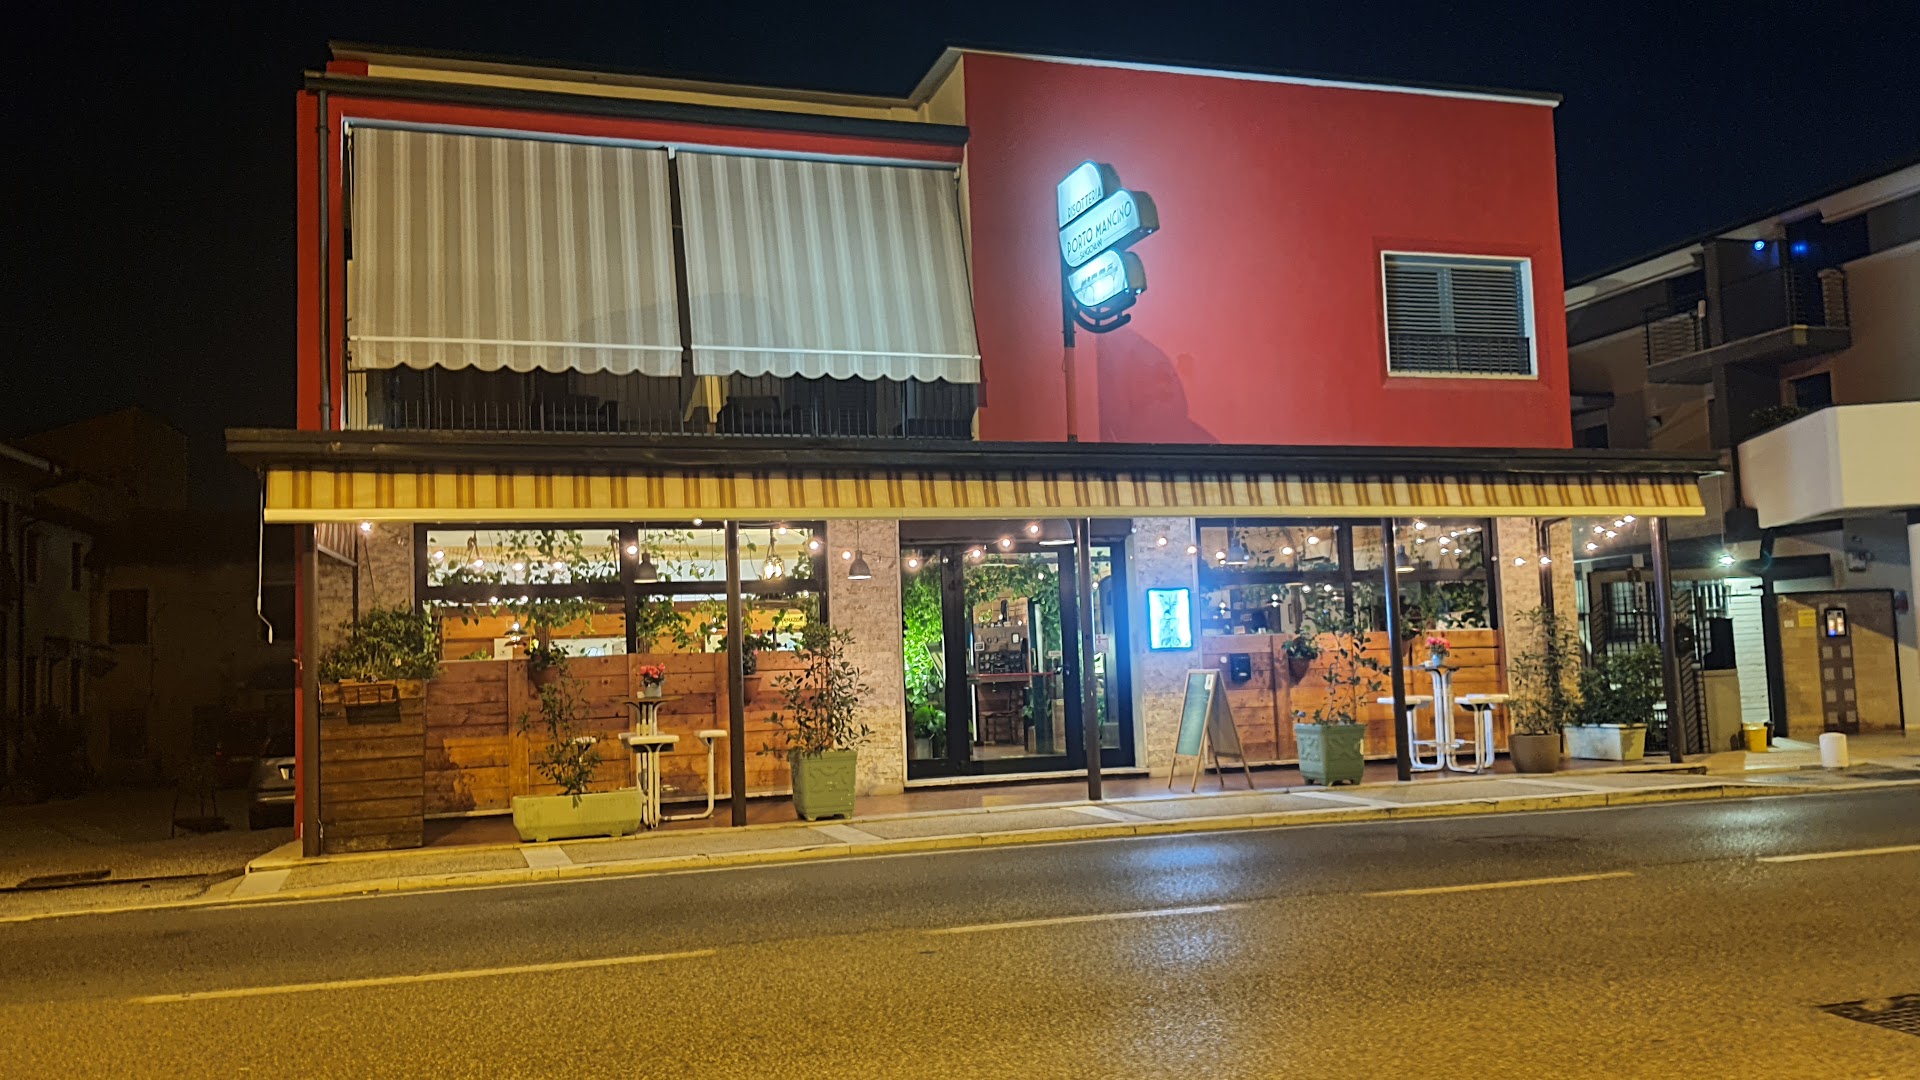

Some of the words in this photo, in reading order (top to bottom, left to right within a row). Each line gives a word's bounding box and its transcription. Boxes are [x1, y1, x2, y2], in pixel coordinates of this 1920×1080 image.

[1067, 186, 1101, 219] RISOTTERIA
[1067, 228, 1093, 257] PORTO
[1095, 201, 1132, 238] MANCINO
